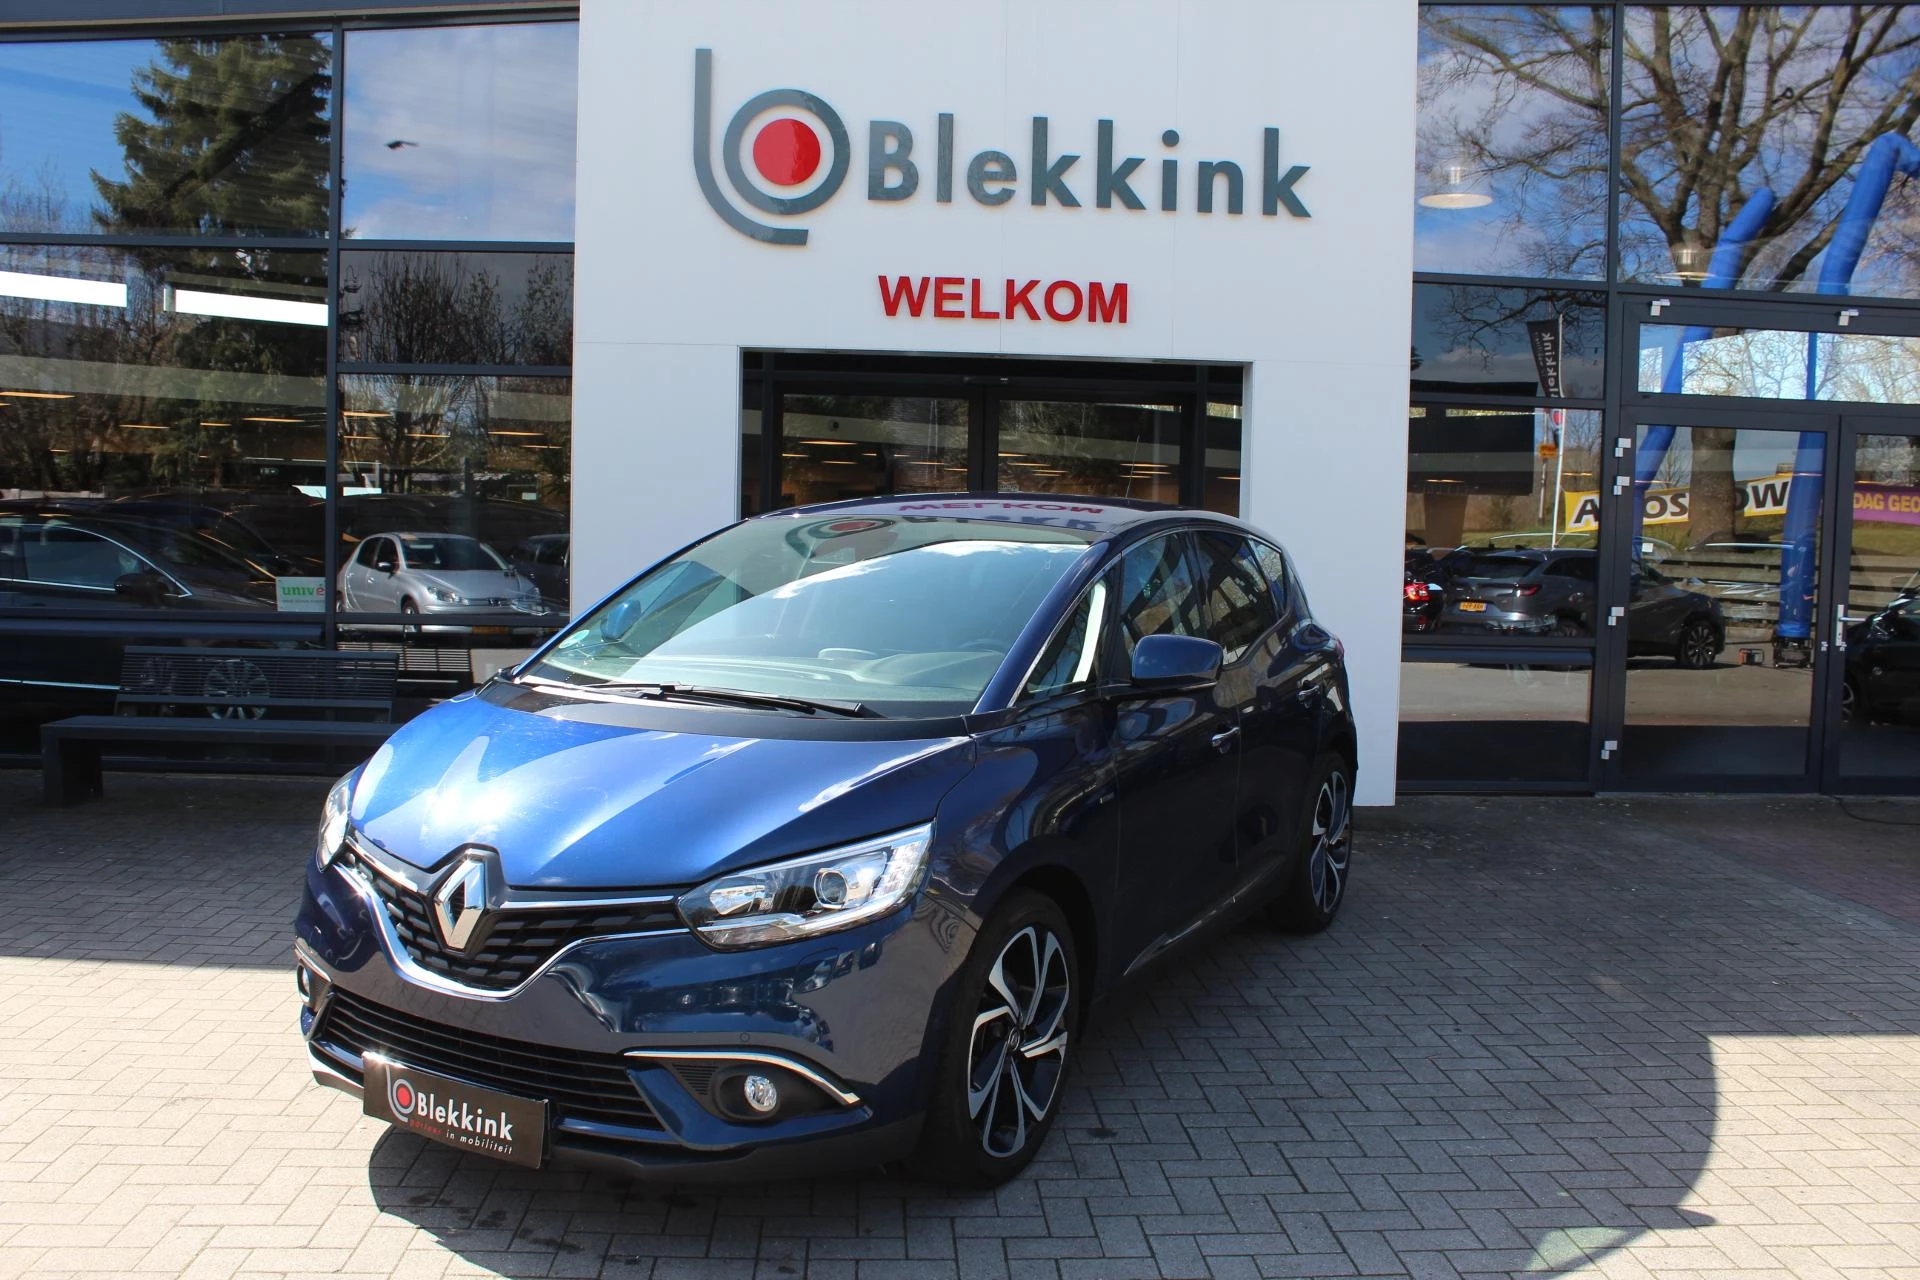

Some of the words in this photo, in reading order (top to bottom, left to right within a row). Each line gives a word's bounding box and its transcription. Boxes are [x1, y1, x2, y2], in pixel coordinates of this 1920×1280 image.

[867, 112, 1312, 218] Blekkink
[877, 274, 1129, 324] WELKOM
[417, 1091, 513, 1141] Blekkink
[446, 1129, 455, 1140] in
[459, 1135, 513, 1155] mobiliteit
